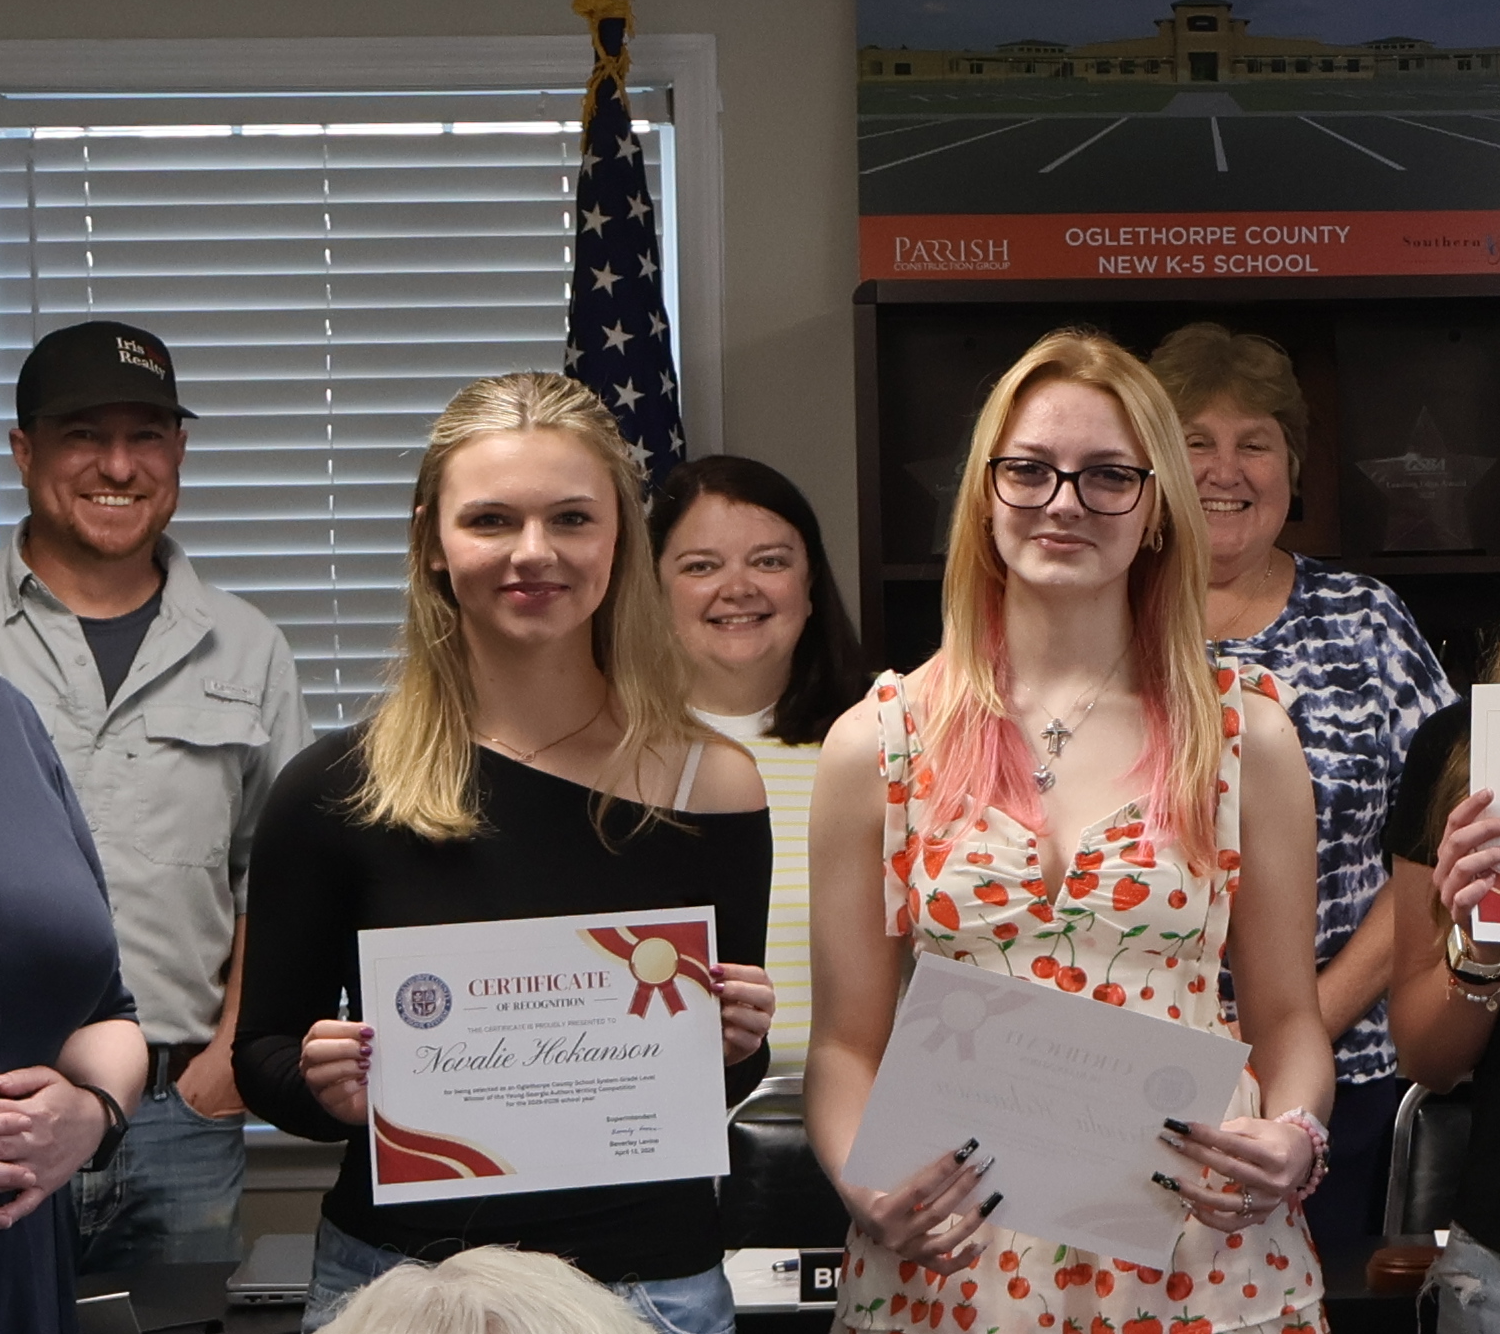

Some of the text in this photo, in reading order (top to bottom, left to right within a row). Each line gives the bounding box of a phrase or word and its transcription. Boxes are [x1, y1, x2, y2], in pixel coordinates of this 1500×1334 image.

[1065, 225, 1350, 247] OGLETHORPE COUNTY
[1403, 235, 1481, 248] Southern
[975, 262, 1011, 271] GROUP
[1098, 255, 1318, 274] NEW K-5 SCHOOL
[115, 336, 145, 356] Iris
[118, 350, 166, 381] Realty
[467, 968, 611, 998] CERTIFICATE
[496, 996, 585, 1011] OF RECOGNITION
[521, 1030, 660, 1067] Hokanson
